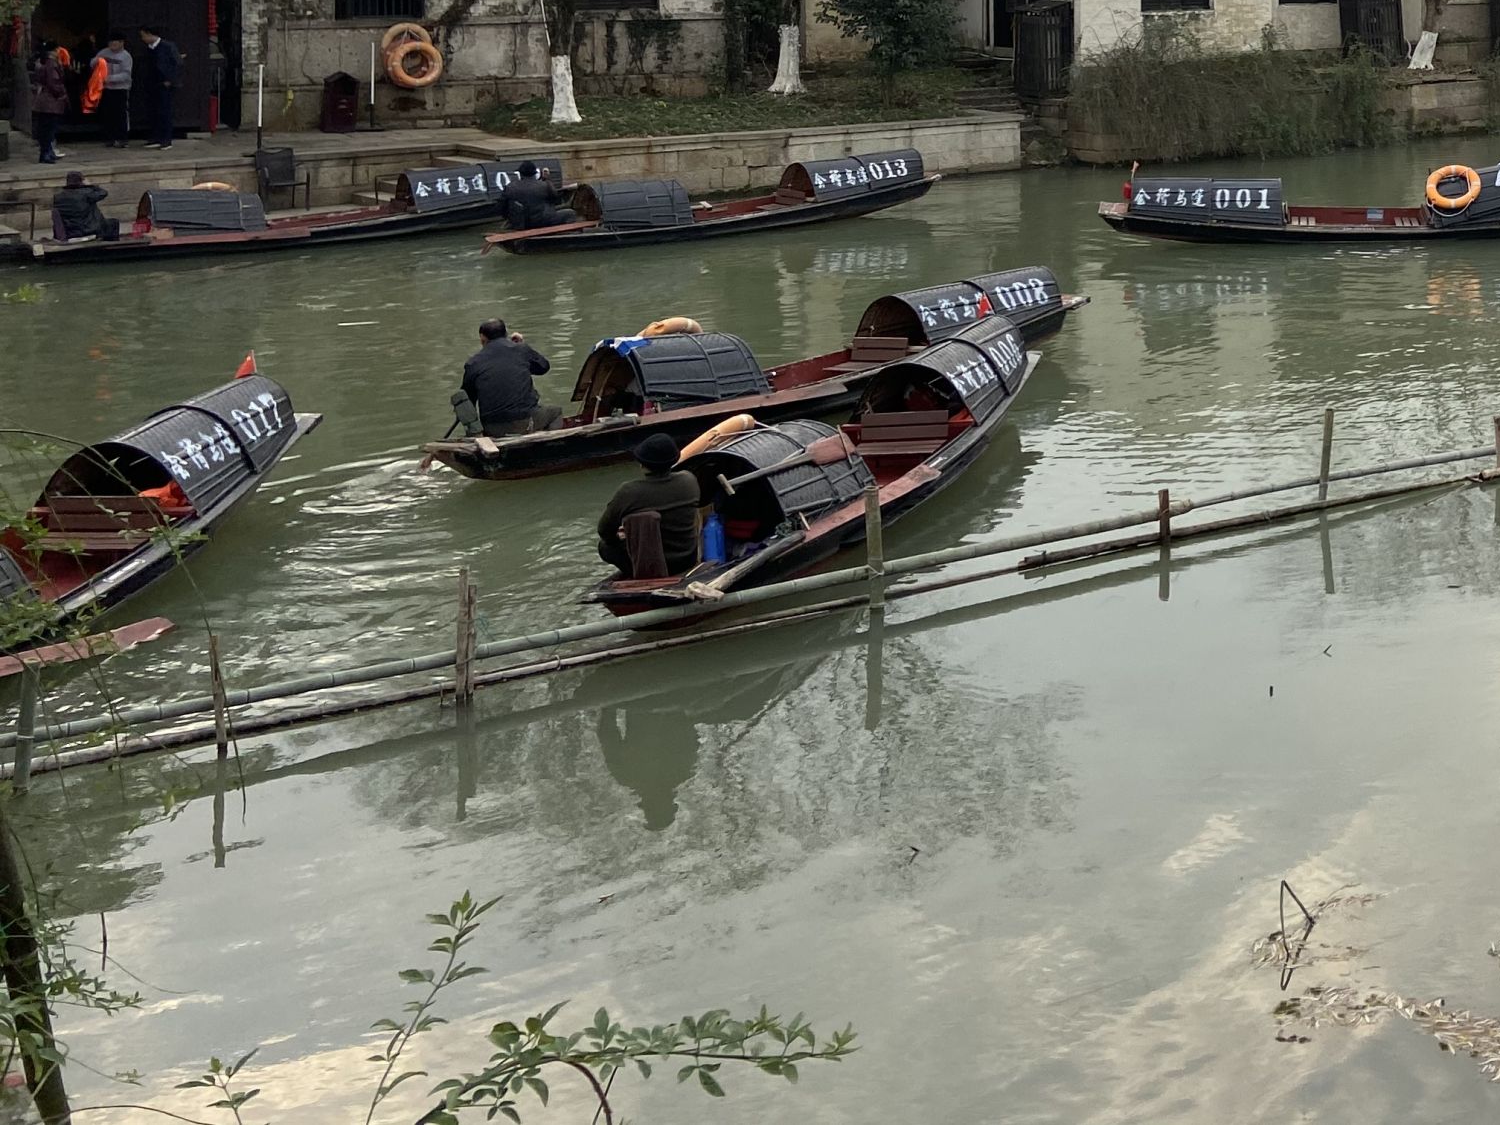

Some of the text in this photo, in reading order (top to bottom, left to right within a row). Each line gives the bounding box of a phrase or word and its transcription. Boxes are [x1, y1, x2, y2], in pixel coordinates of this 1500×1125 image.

[868, 158, 908, 180] 013
[1215, 188, 1271, 209] 001
[994, 277, 1049, 311] 008
[988, 333, 1022, 376] 006
[230, 392, 283, 443] 017
